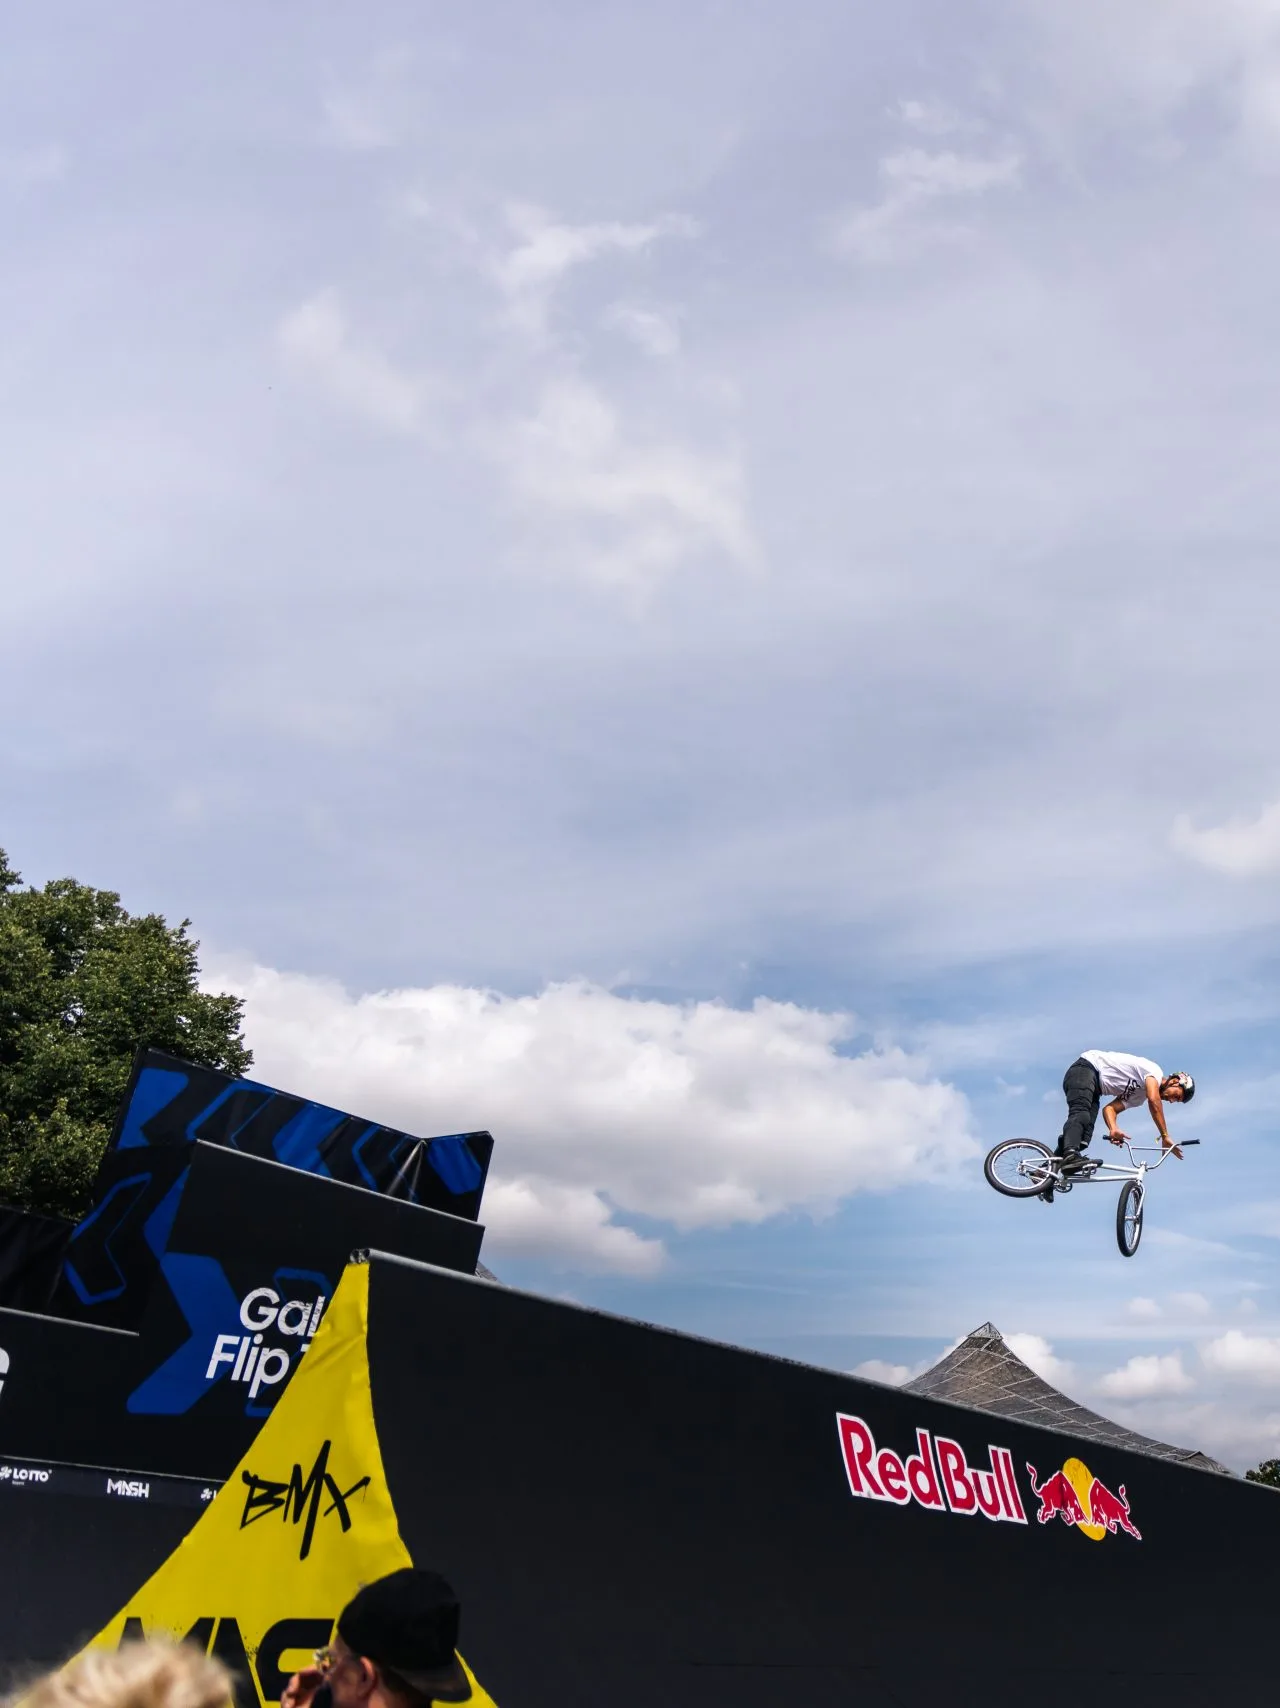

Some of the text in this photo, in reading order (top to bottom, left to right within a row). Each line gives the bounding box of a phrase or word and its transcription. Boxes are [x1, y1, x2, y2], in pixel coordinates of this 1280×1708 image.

[205, 1333, 290, 1398] Flip
[13, 1467, 50, 1483] LOTTO
[106, 1478, 150, 1498] MASH
[239, 1439, 371, 1561] BMX
